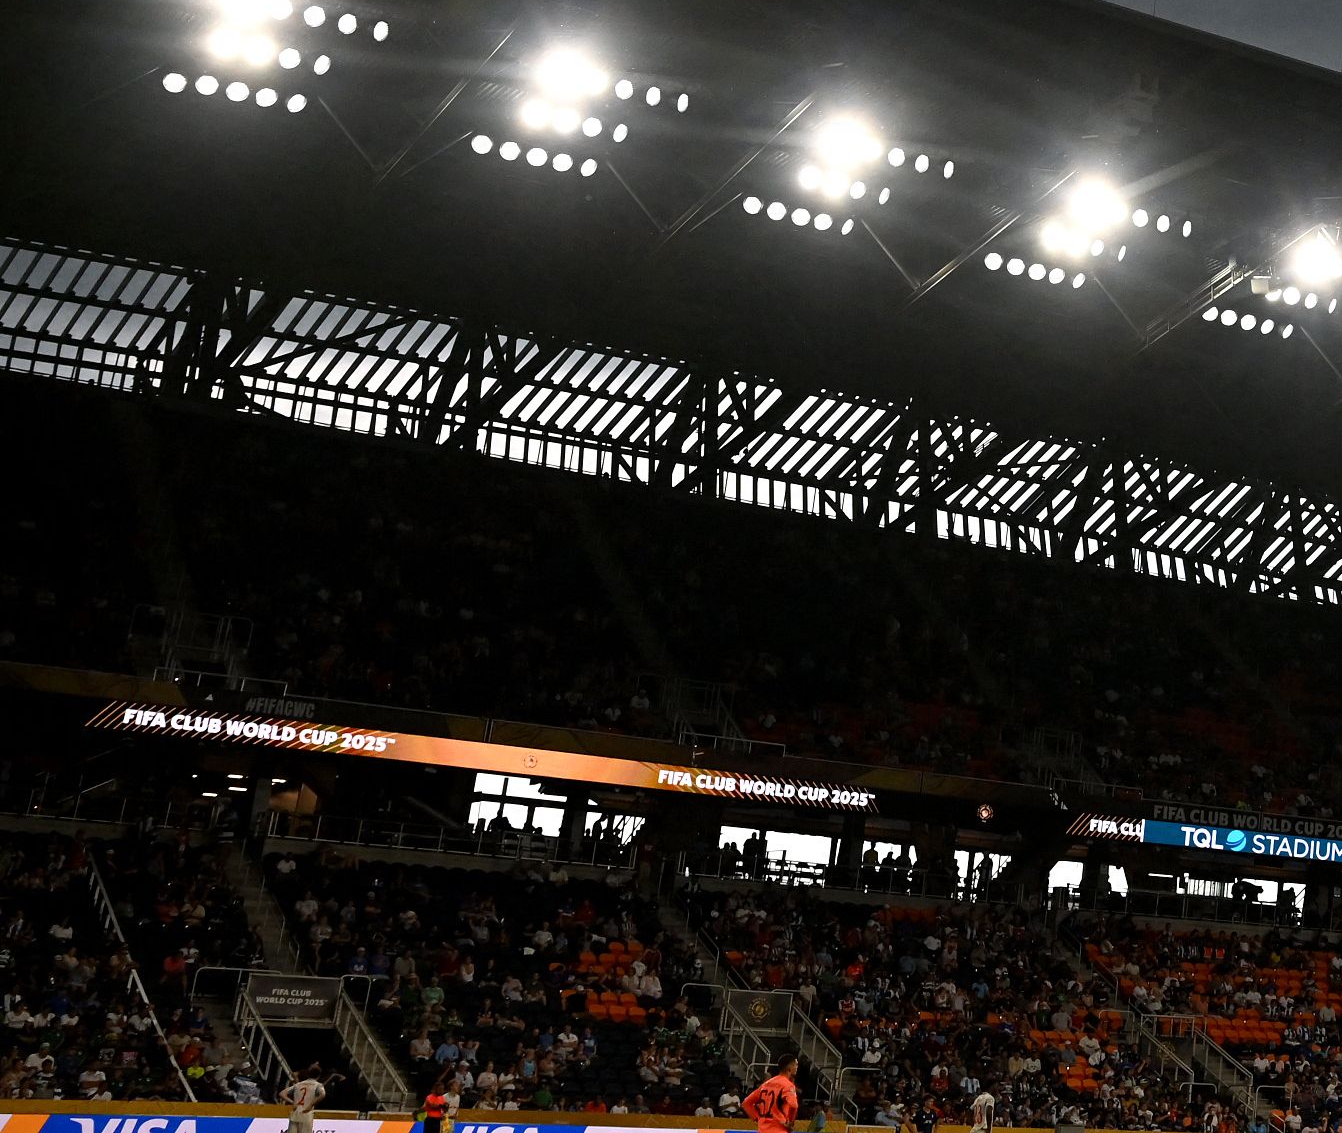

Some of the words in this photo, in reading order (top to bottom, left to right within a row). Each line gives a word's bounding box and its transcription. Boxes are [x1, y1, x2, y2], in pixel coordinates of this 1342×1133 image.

[245, 697, 316, 719] #FIFACWC
[123, 708, 166, 728] FIFA
[171, 714, 221, 734] CLUB
[226, 720, 296, 742] WORLD
[299, 728, 337, 746] CUP
[658, 770, 692, 787] FIFA
[695, 774, 736, 791] CLUB
[739, 779, 795, 798] WORLD
[798, 786, 828, 802] CUP
[1089, 819, 1118, 834] FIFA
[1152, 804, 1187, 821] FIFA
[1189, 808, 1229, 827] CLUB
[1232, 813, 1291, 833] WORLD
[1294, 820, 1324, 836] CUP
[1181, 826, 1224, 850] TQL
[255, 996, 286, 1005] WORLD
[287, 998, 303, 1006] CUP
[272, 988, 289, 997] FIFA
[290, 989, 312, 997] CLUB
[298, 1087, 307, 1106] 2
[758, 1090, 775, 1117] 52
